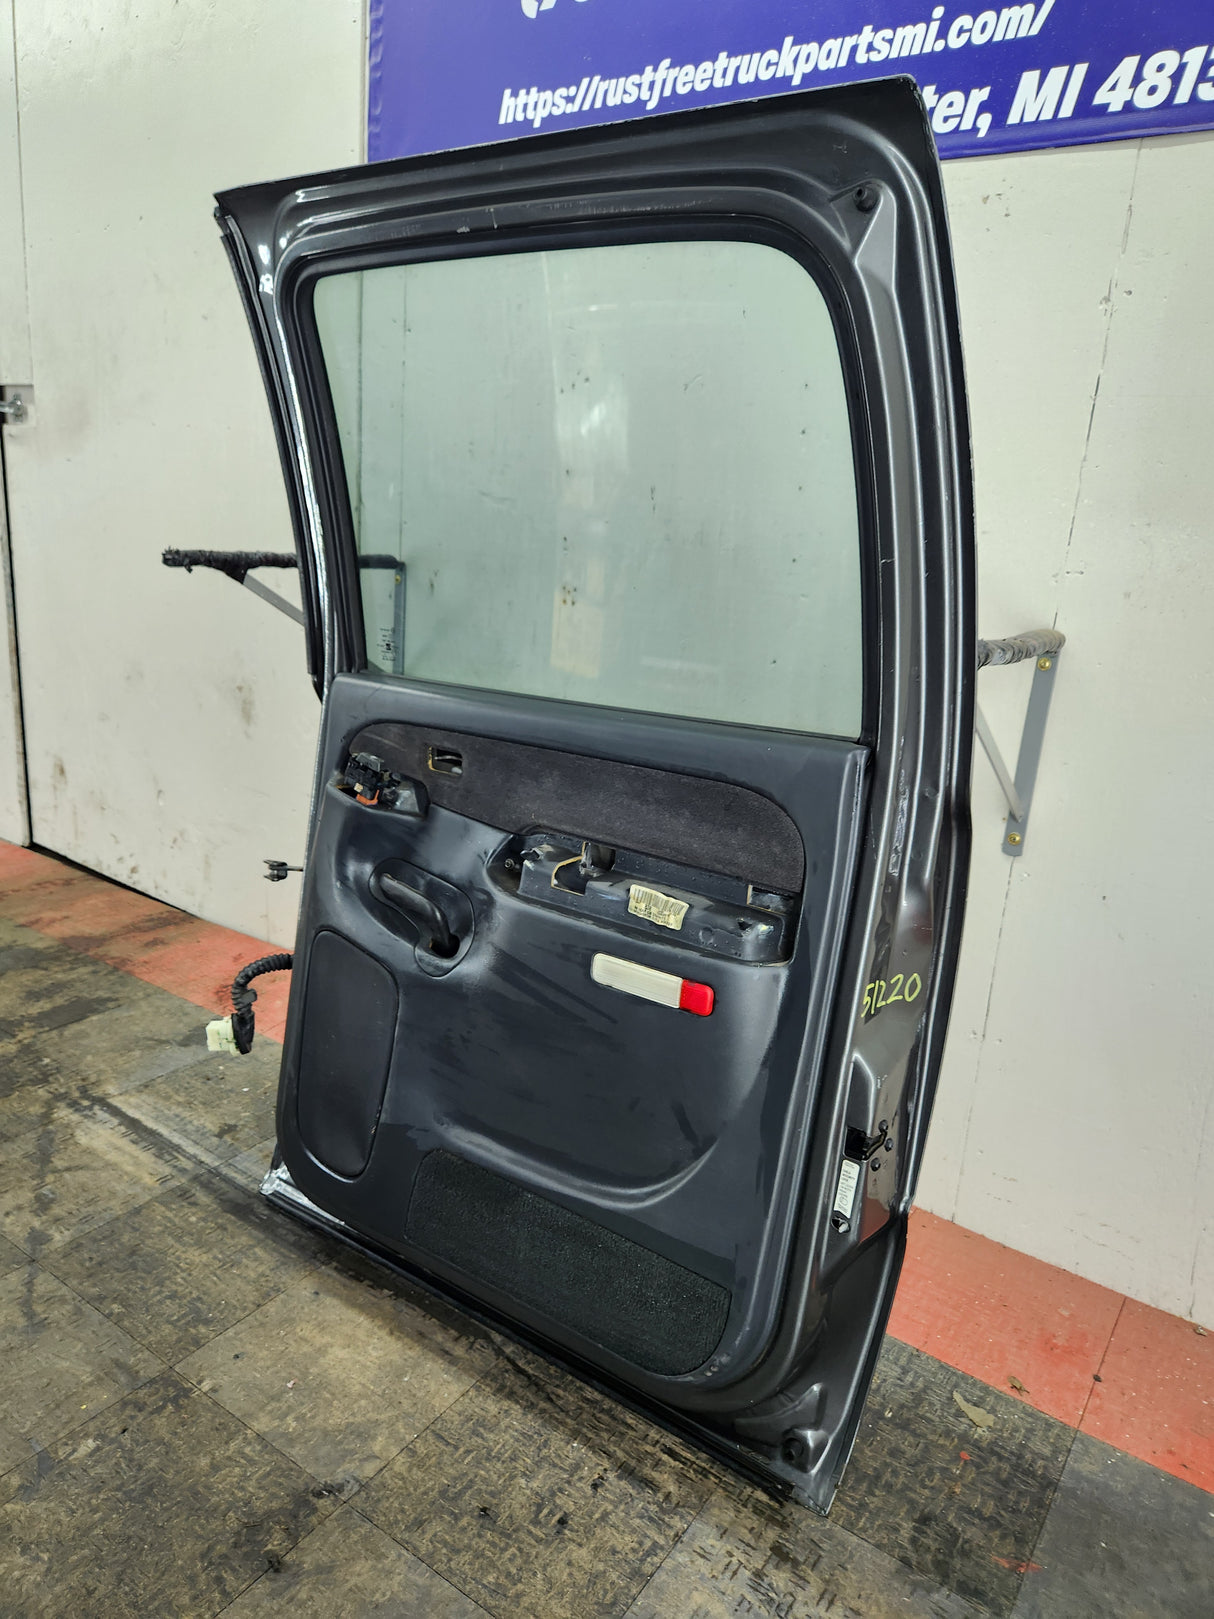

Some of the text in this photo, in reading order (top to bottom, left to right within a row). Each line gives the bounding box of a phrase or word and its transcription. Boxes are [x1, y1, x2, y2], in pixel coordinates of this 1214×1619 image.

[498, 0, 1053, 128] https://rustfreetruckpartsmi.com/
[1006, 62, 1089, 125] MI
[861, 973, 922, 1018] 51220
